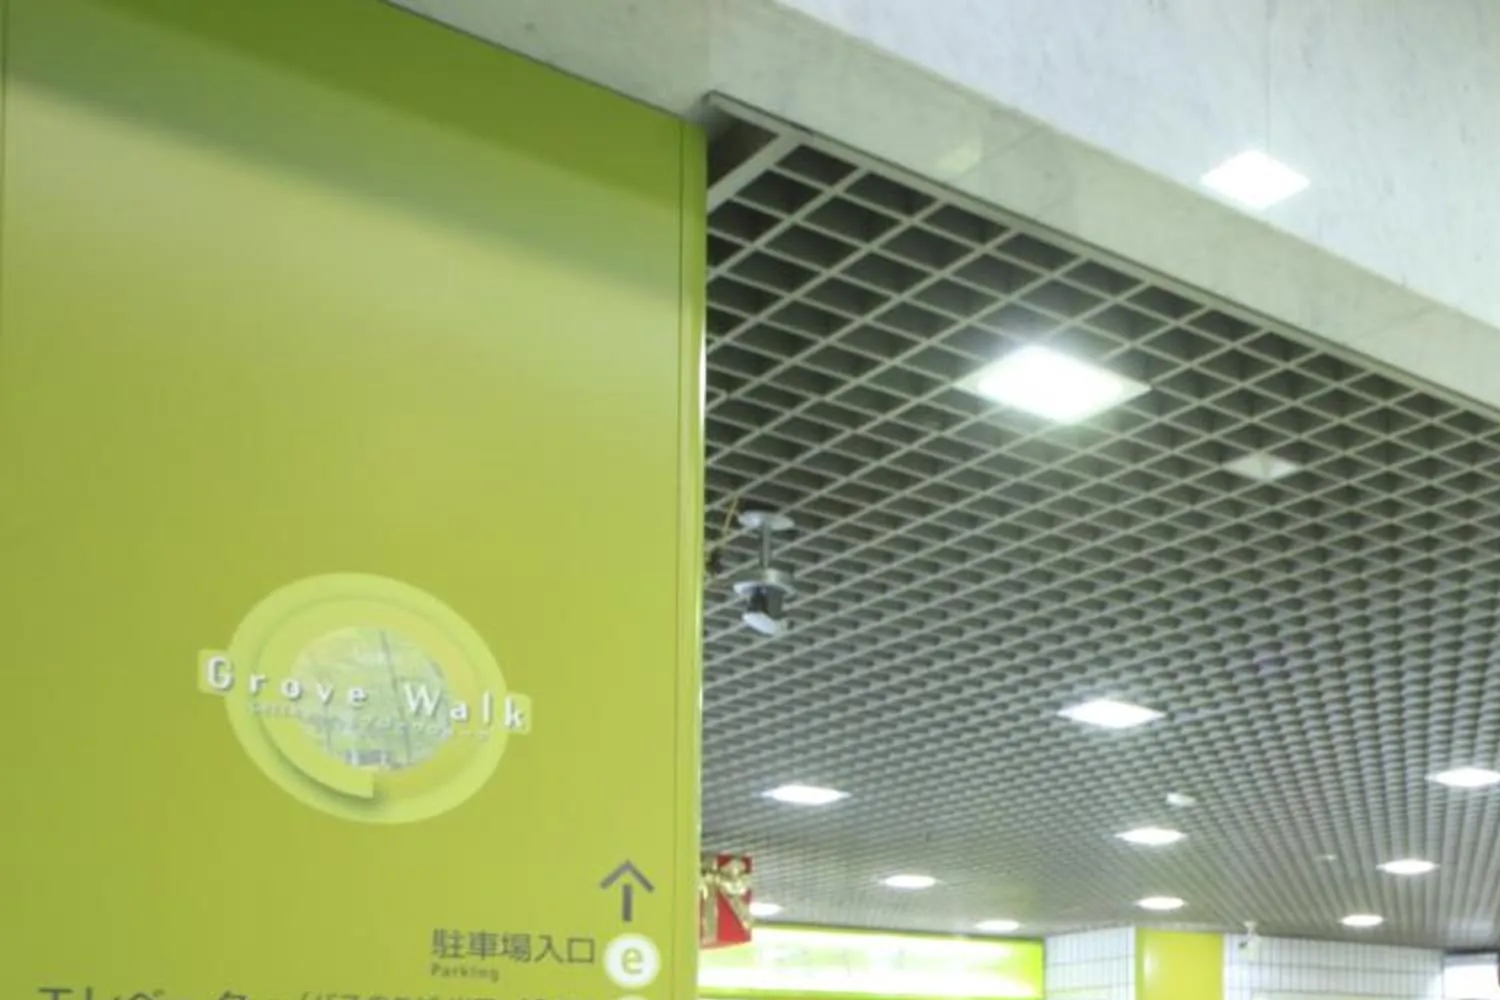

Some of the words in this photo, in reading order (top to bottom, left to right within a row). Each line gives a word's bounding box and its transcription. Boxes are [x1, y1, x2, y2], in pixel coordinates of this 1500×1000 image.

[206, 655, 368, 707] Grove
[403, 682, 526, 730] Walk
[431, 928, 595, 964] 駐車場入口
[430, 963, 500, 982] Parking
